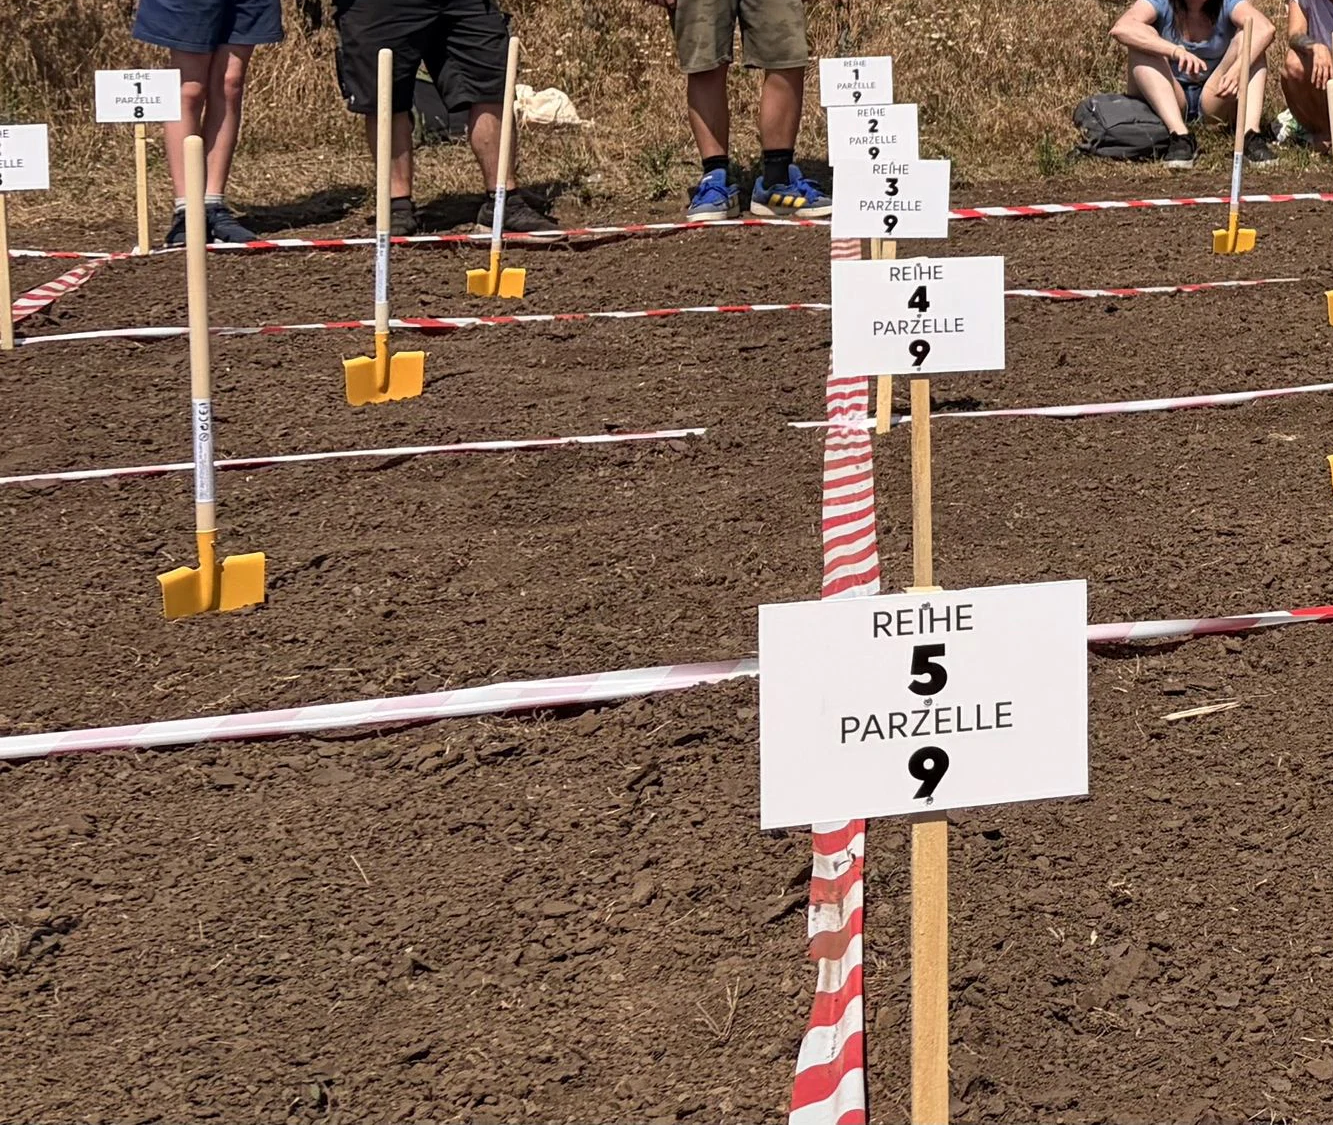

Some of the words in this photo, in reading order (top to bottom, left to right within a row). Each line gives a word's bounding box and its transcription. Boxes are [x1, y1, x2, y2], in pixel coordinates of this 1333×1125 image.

[134, 82, 142, 94] 1
[133, 106, 144, 119] 8
[857, 107, 886, 117] REIHE
[868, 118, 879, 134] 2
[849, 135, 897, 145] PARZELLE
[868, 146, 880, 160] 9
[873, 163, 910, 175] REIHE
[884, 177, 899, 197] 3
[860, 200, 922, 212] PARZELLE
[883, 214, 898, 234] 9
[890, 264, 944, 282] REIHE
[907, 285, 930, 313] 4
[873, 318, 965, 336] PARZELLE
[908, 339, 931, 367] 9
[872, 604, 974, 638] REIHE
[907, 643, 948, 696] 5
[840, 701, 1014, 744] PARZELLE
[908, 746, 949, 800] 9
